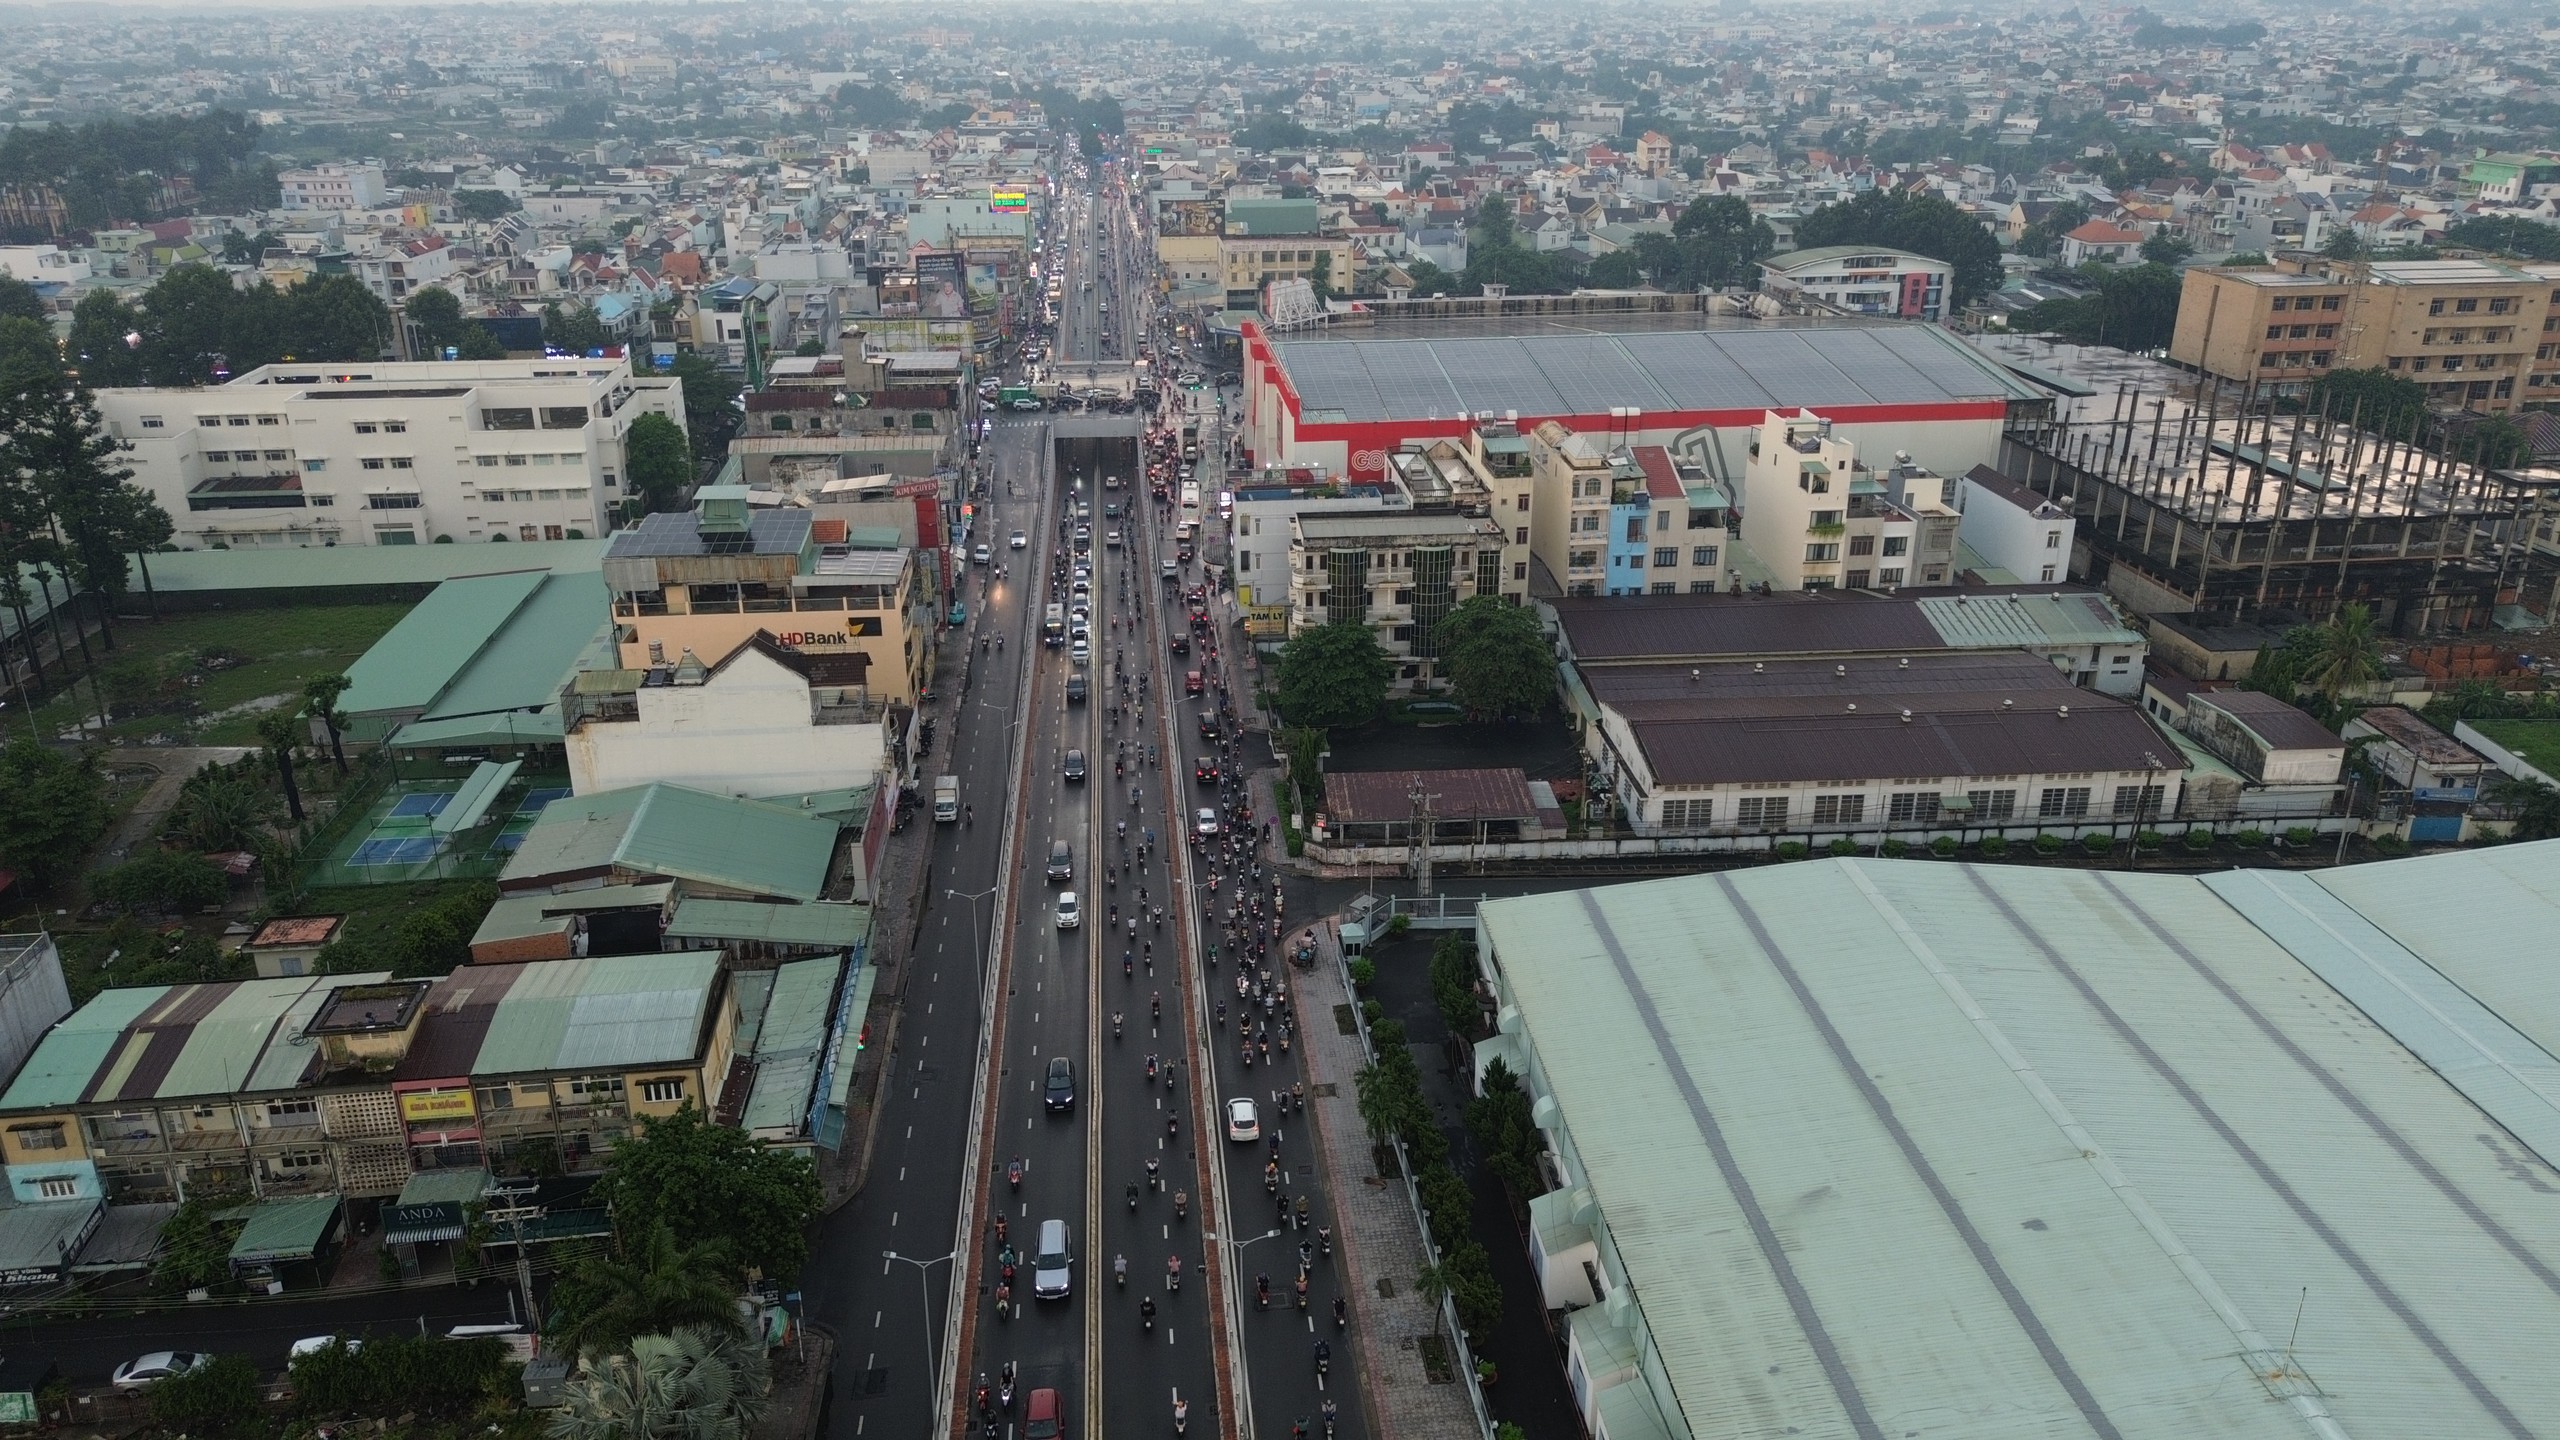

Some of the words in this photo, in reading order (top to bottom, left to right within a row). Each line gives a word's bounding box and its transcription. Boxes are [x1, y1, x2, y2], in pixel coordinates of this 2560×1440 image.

[896, 486, 910, 497] KIM
[780, 631, 847, 646] HDBank
[399, 1207, 445, 1220] ANDA
